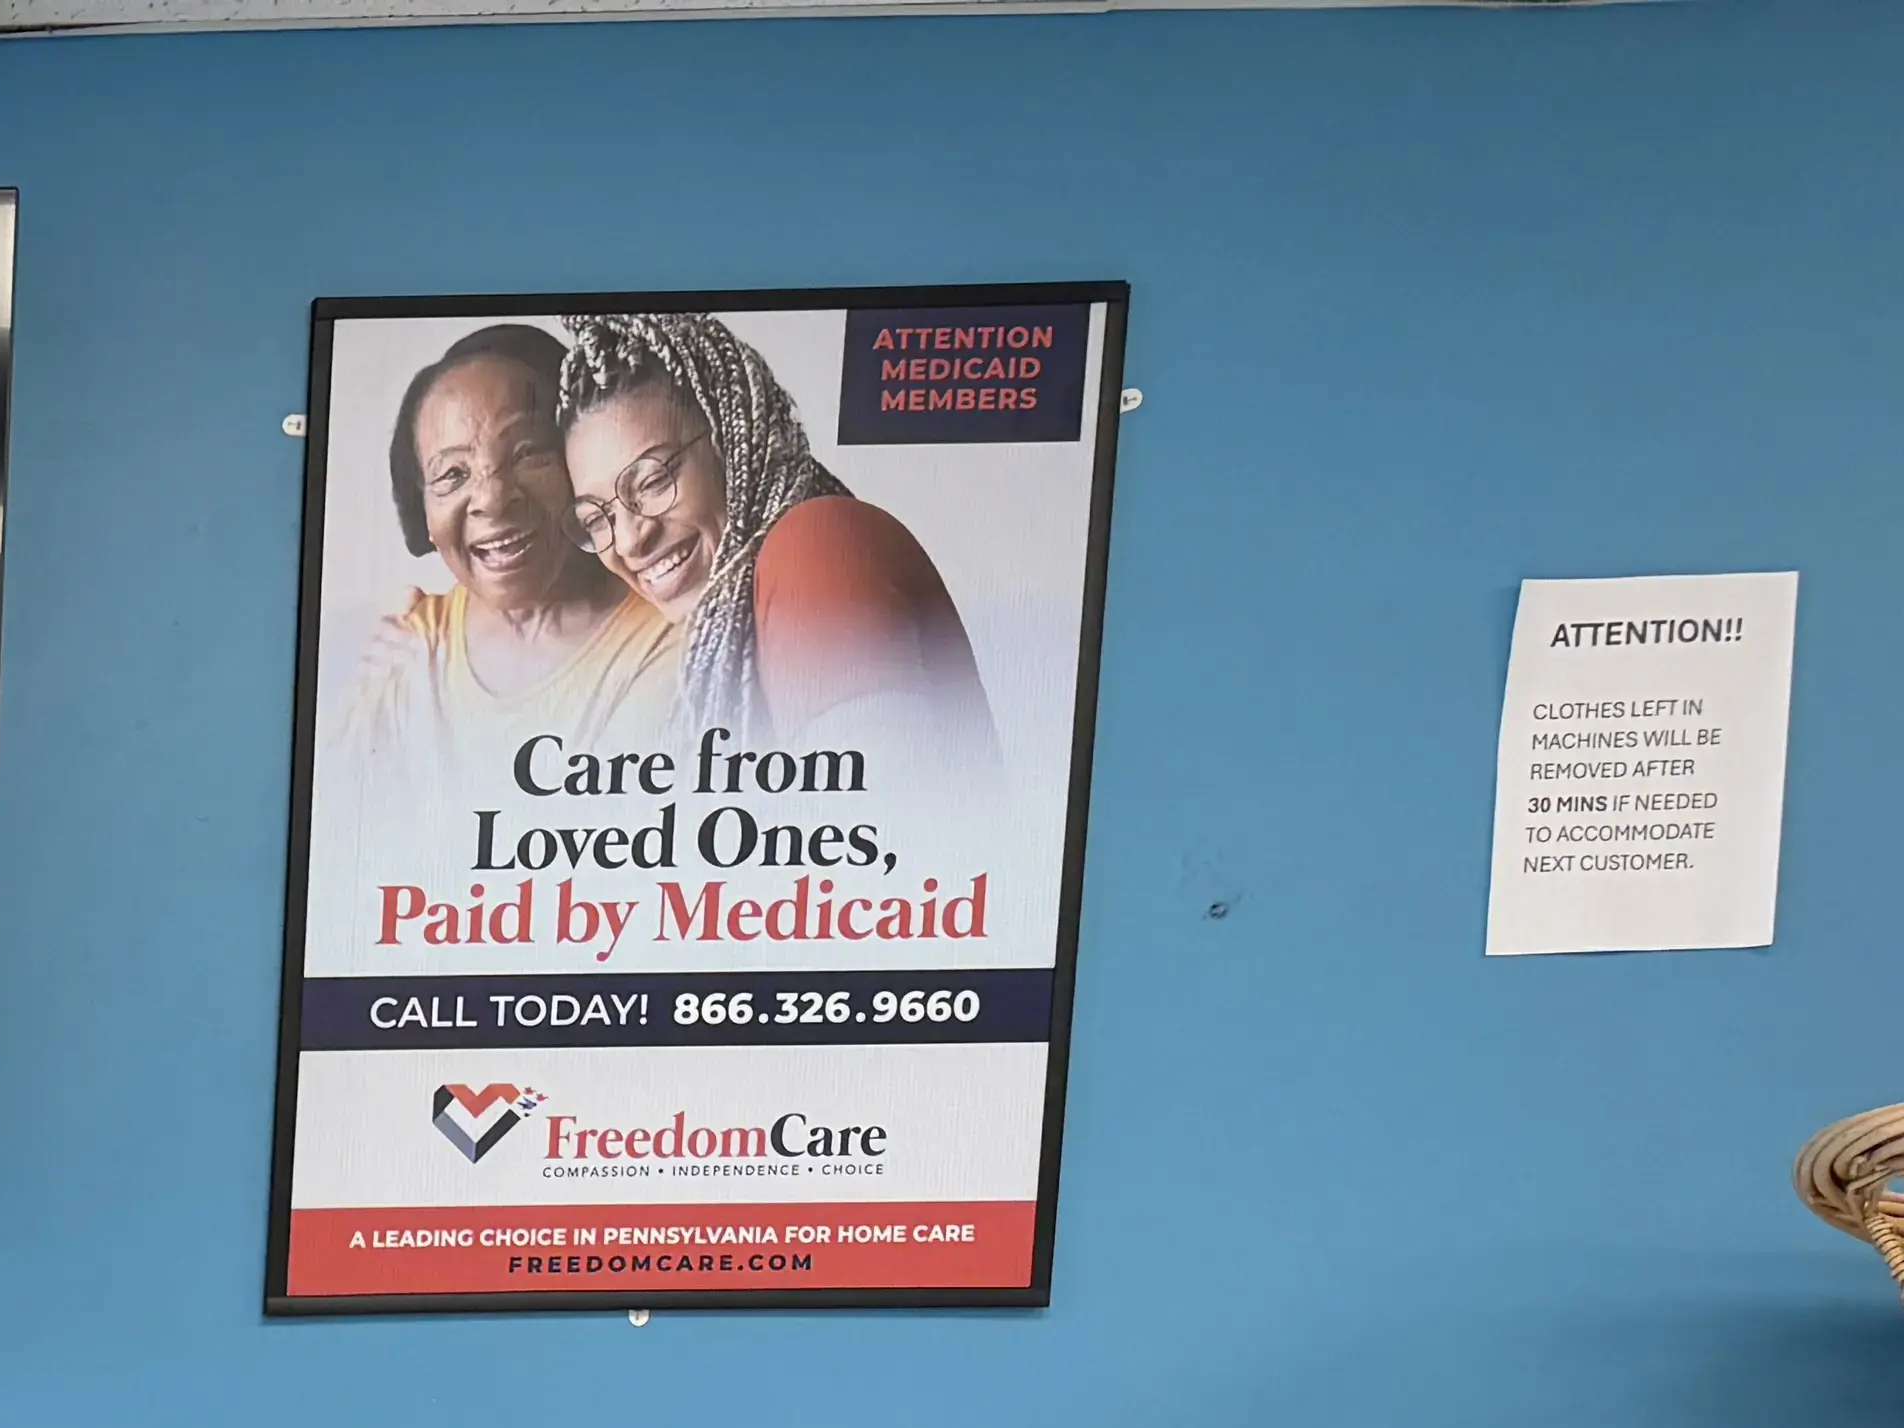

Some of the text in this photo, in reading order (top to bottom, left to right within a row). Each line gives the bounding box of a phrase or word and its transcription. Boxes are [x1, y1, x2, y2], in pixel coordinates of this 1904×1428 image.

[873, 326, 1052, 350] ATTENTION
[880, 358, 1041, 381] MEDICAID
[880, 388, 1037, 411] MEMBERS
[1550, 617, 1744, 648] ATTENTION!!
[1533, 699, 1703, 720] CLOTHES LEFT IN
[1531, 728, 1722, 750] MACHINES WILL BE
[513, 727, 867, 796] Care from
[1530, 759, 1695, 780] REMOVED AFTER
[1527, 792, 1718, 814] 30 MINS IF NEEDED
[471, 802, 898, 876] Loved Ones,
[1525, 822, 1715, 843] TO ACCOMMODATE
[1523, 853, 1694, 873] NEXT CUSTOMER.
[375, 873, 989, 962] Paid by Medicaid
[371, 989, 981, 1028] CALL TODAY! 866.326.9660
[544, 1111, 887, 1159] FreedomCare
[543, 1164, 884, 1178] COMPASSION INDEPENDENCE CHOICE
[349, 1224, 976, 1248] A LEADING CHOICE IN PENNSYLVANIA FOR HOME CARE
[508, 1254, 812, 1273] FREEDOMCARE.COM
